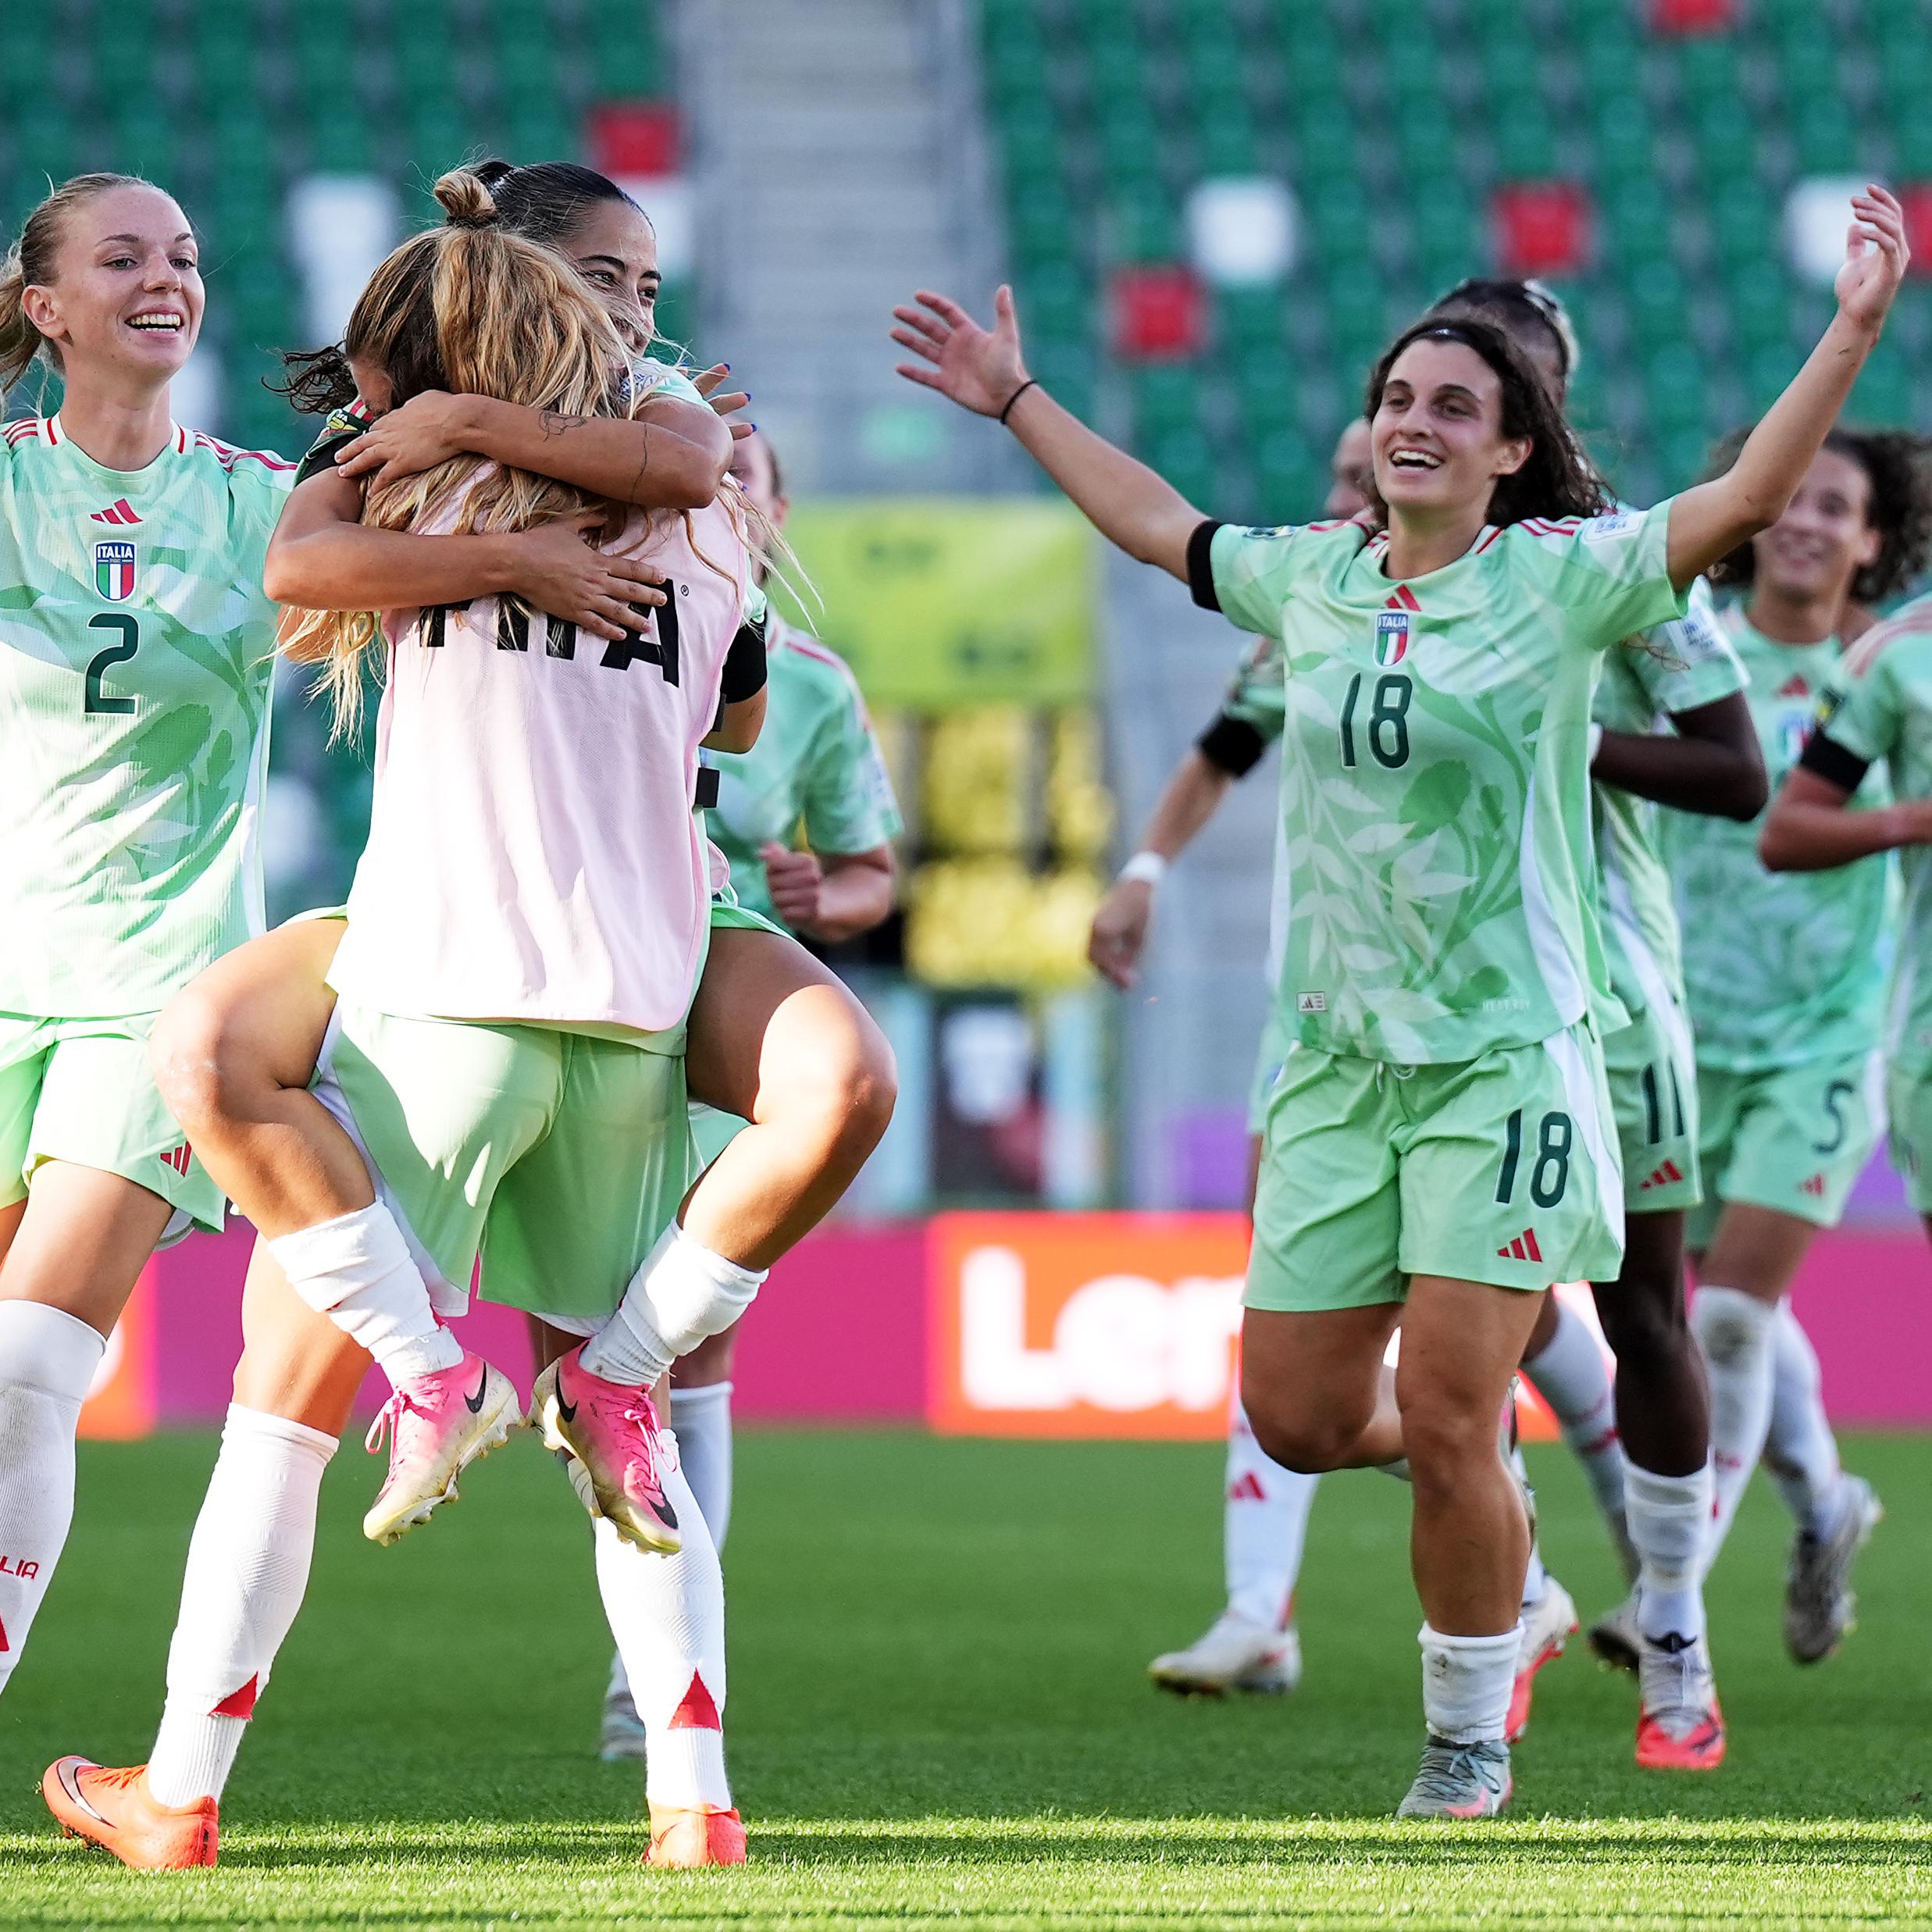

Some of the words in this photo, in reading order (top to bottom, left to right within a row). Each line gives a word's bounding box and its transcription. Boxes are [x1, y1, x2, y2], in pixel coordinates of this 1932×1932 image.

[97, 545, 134, 558] ITALIA
[1378, 615, 1407, 628] ITALIA
[84, 612, 140, 715] 2
[1338, 671, 1413, 769] 18
[1642, 1057, 1685, 1145] 11
[1809, 1077, 1856, 1154] 5
[1494, 1107, 1573, 1210] 18
[0, 1555, 39, 1580] LIA
